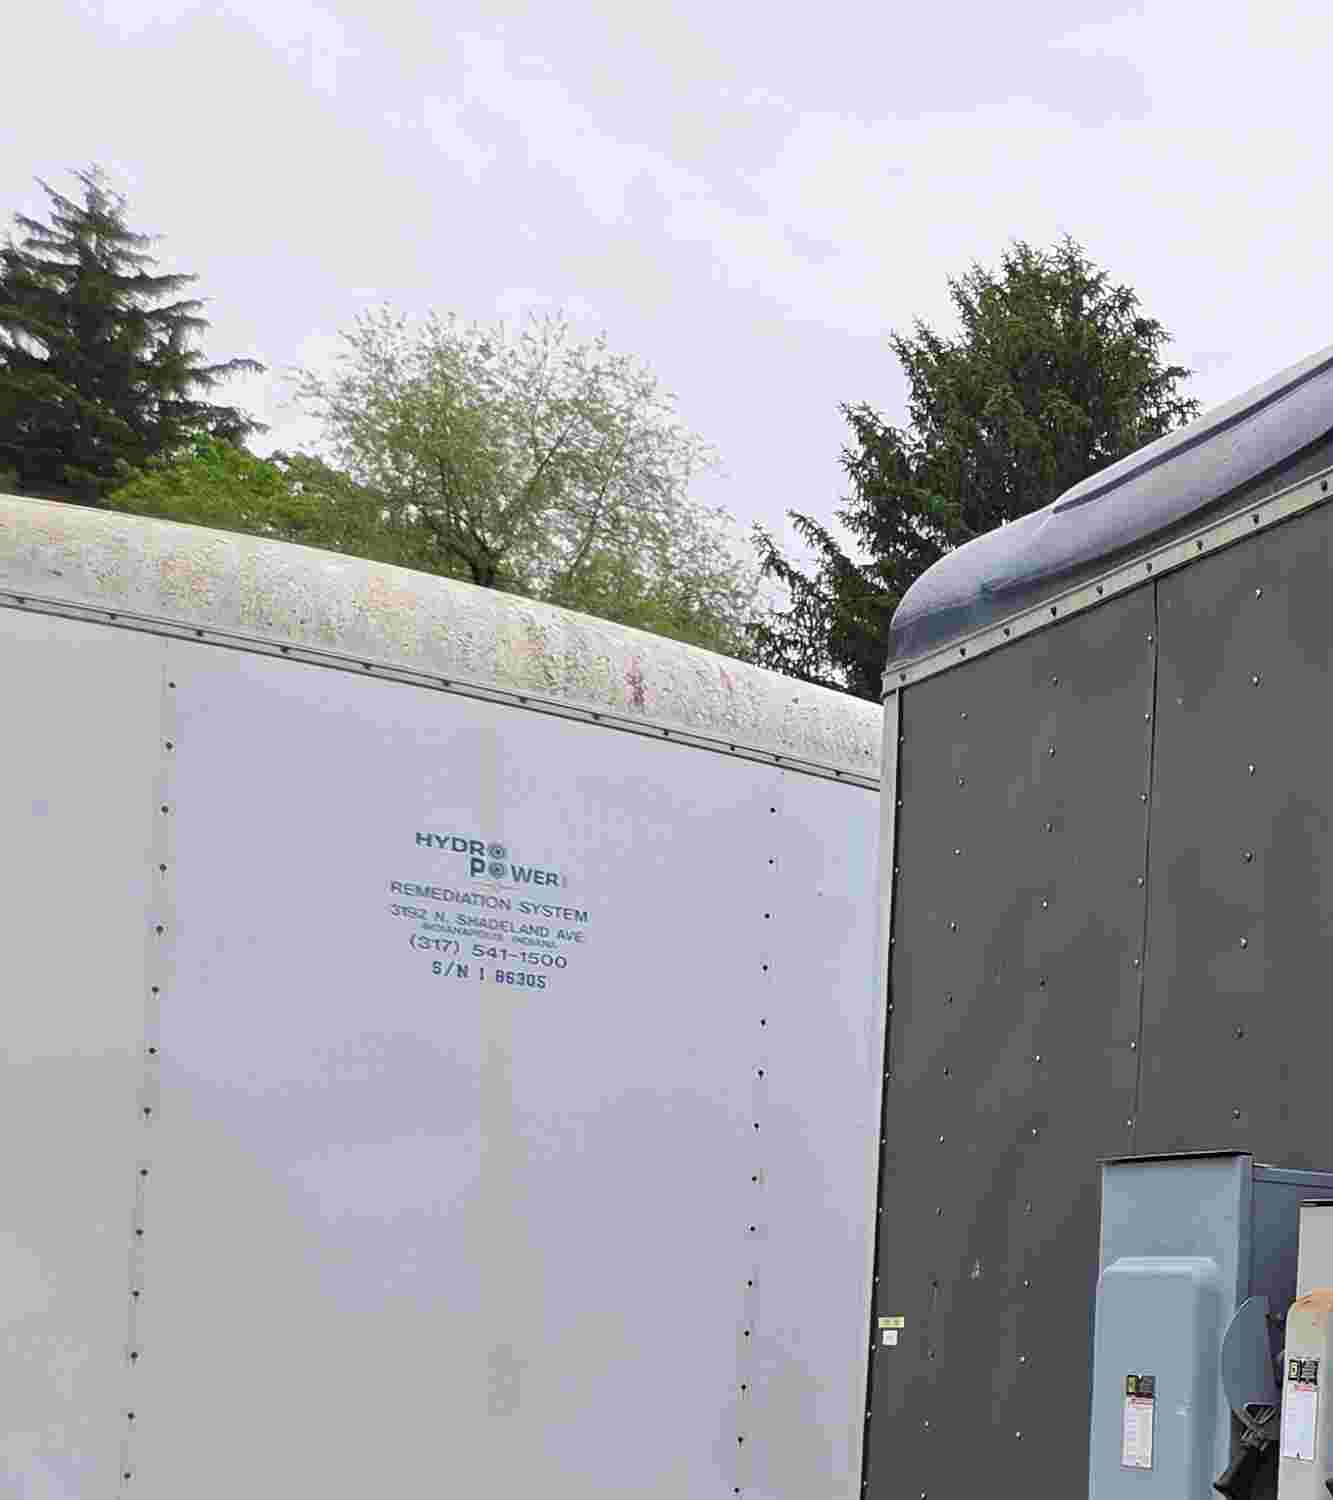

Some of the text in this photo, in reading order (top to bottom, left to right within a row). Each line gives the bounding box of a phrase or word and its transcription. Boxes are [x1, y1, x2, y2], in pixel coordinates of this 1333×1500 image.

[390, 880, 589, 923] REMEDIATION SYSTEM
[455, 913, 550, 938] SHADELAND
[409, 933, 568, 969] (317) 541-1500
[431, 960, 469, 979] S/N
